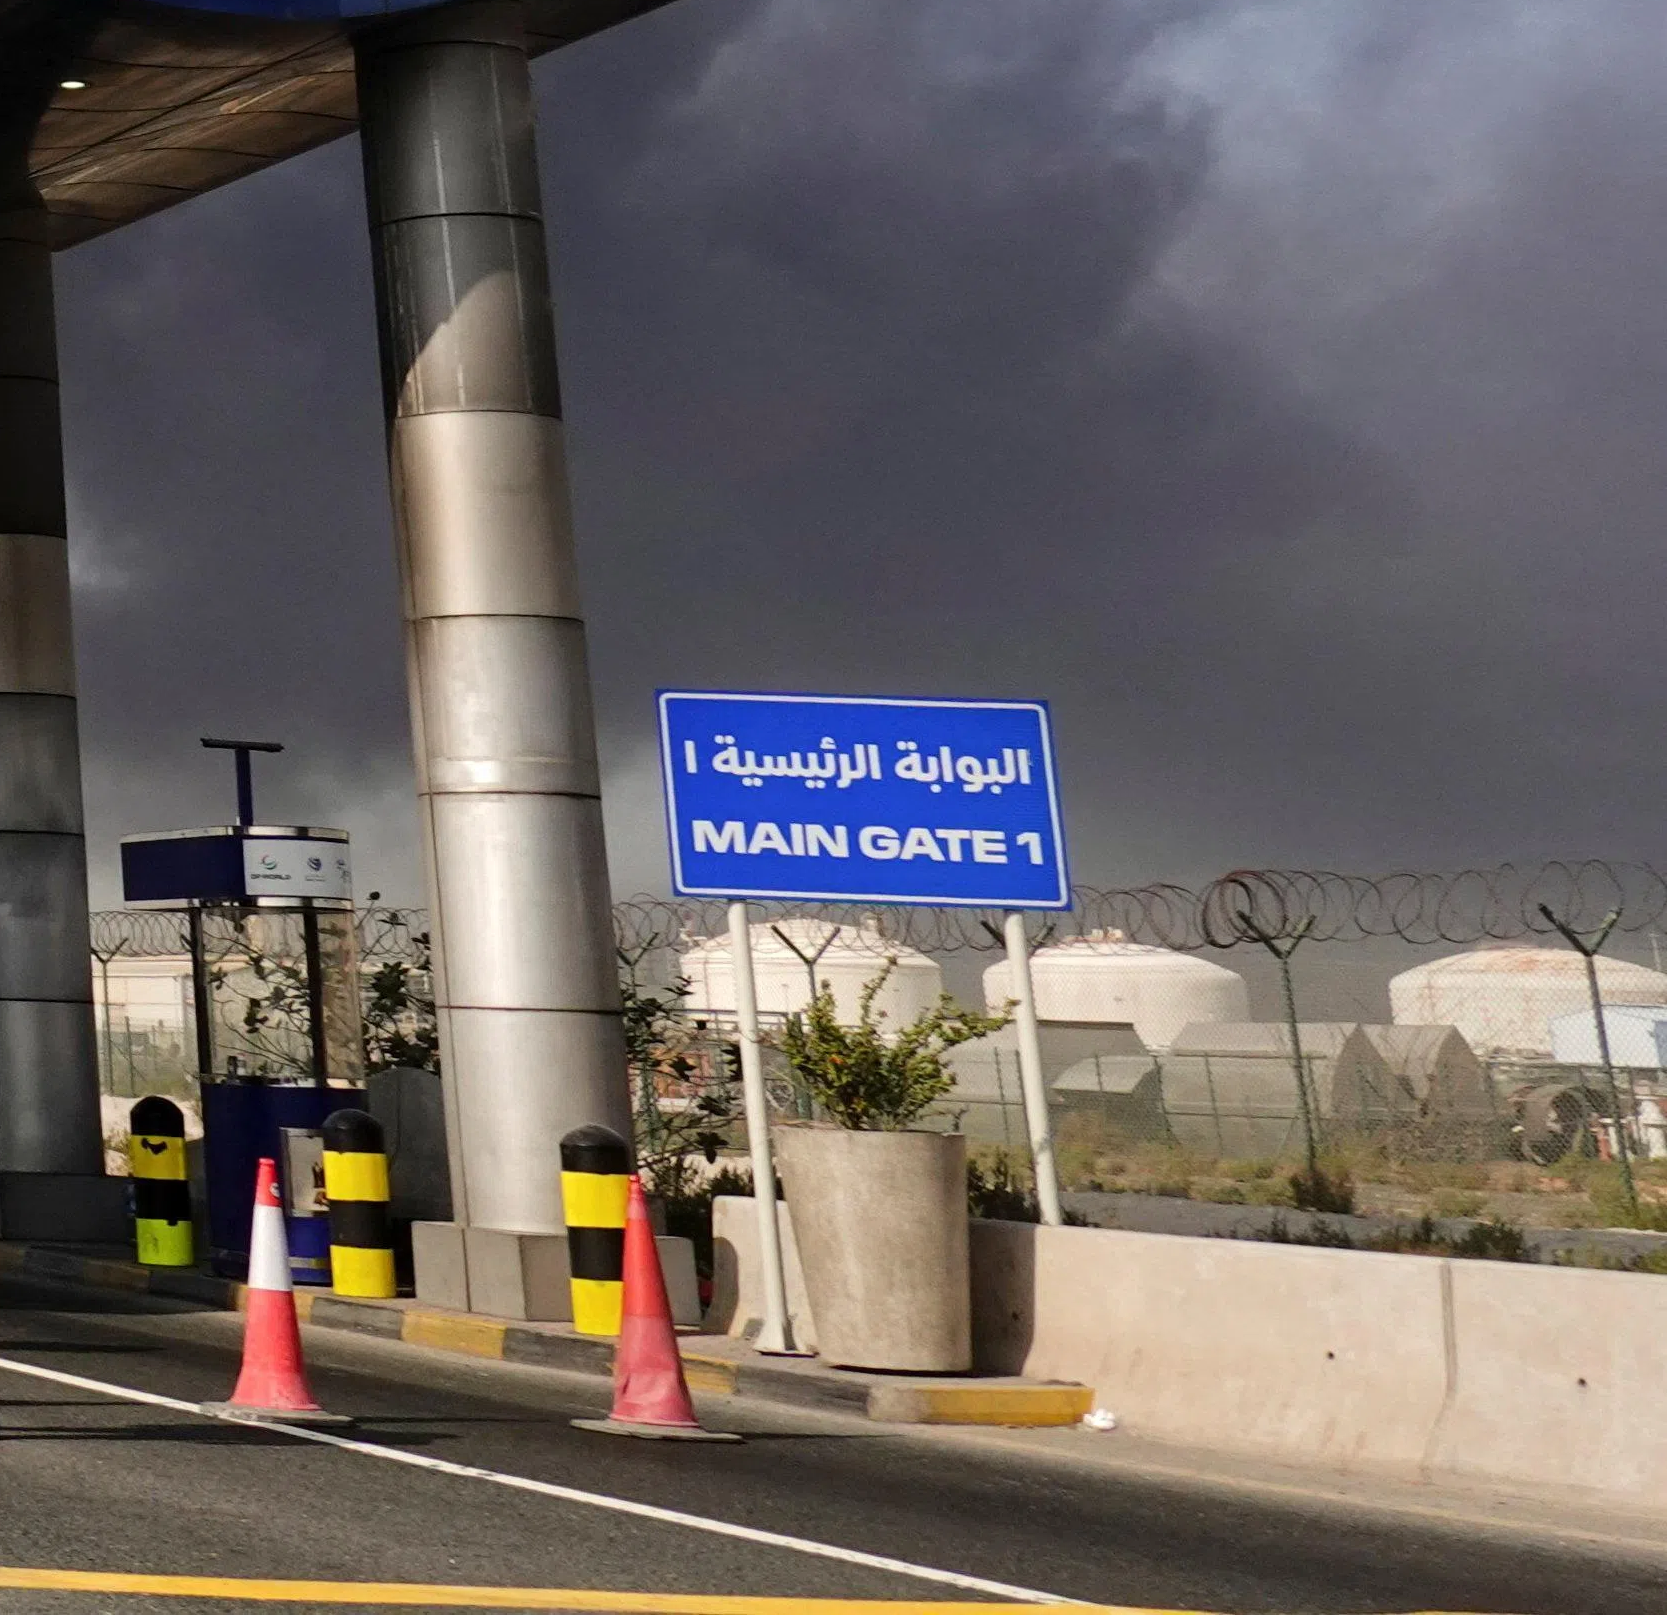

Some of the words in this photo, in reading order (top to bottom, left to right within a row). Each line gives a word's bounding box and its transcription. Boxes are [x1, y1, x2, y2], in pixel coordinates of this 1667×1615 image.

[712, 735, 881, 788] الرئيسية
[896, 740, 1031, 794] البوابة
[693, 820, 849, 858] MAIN
[859, 826, 1008, 864] GATE
[1017, 832, 1044, 865] 1
